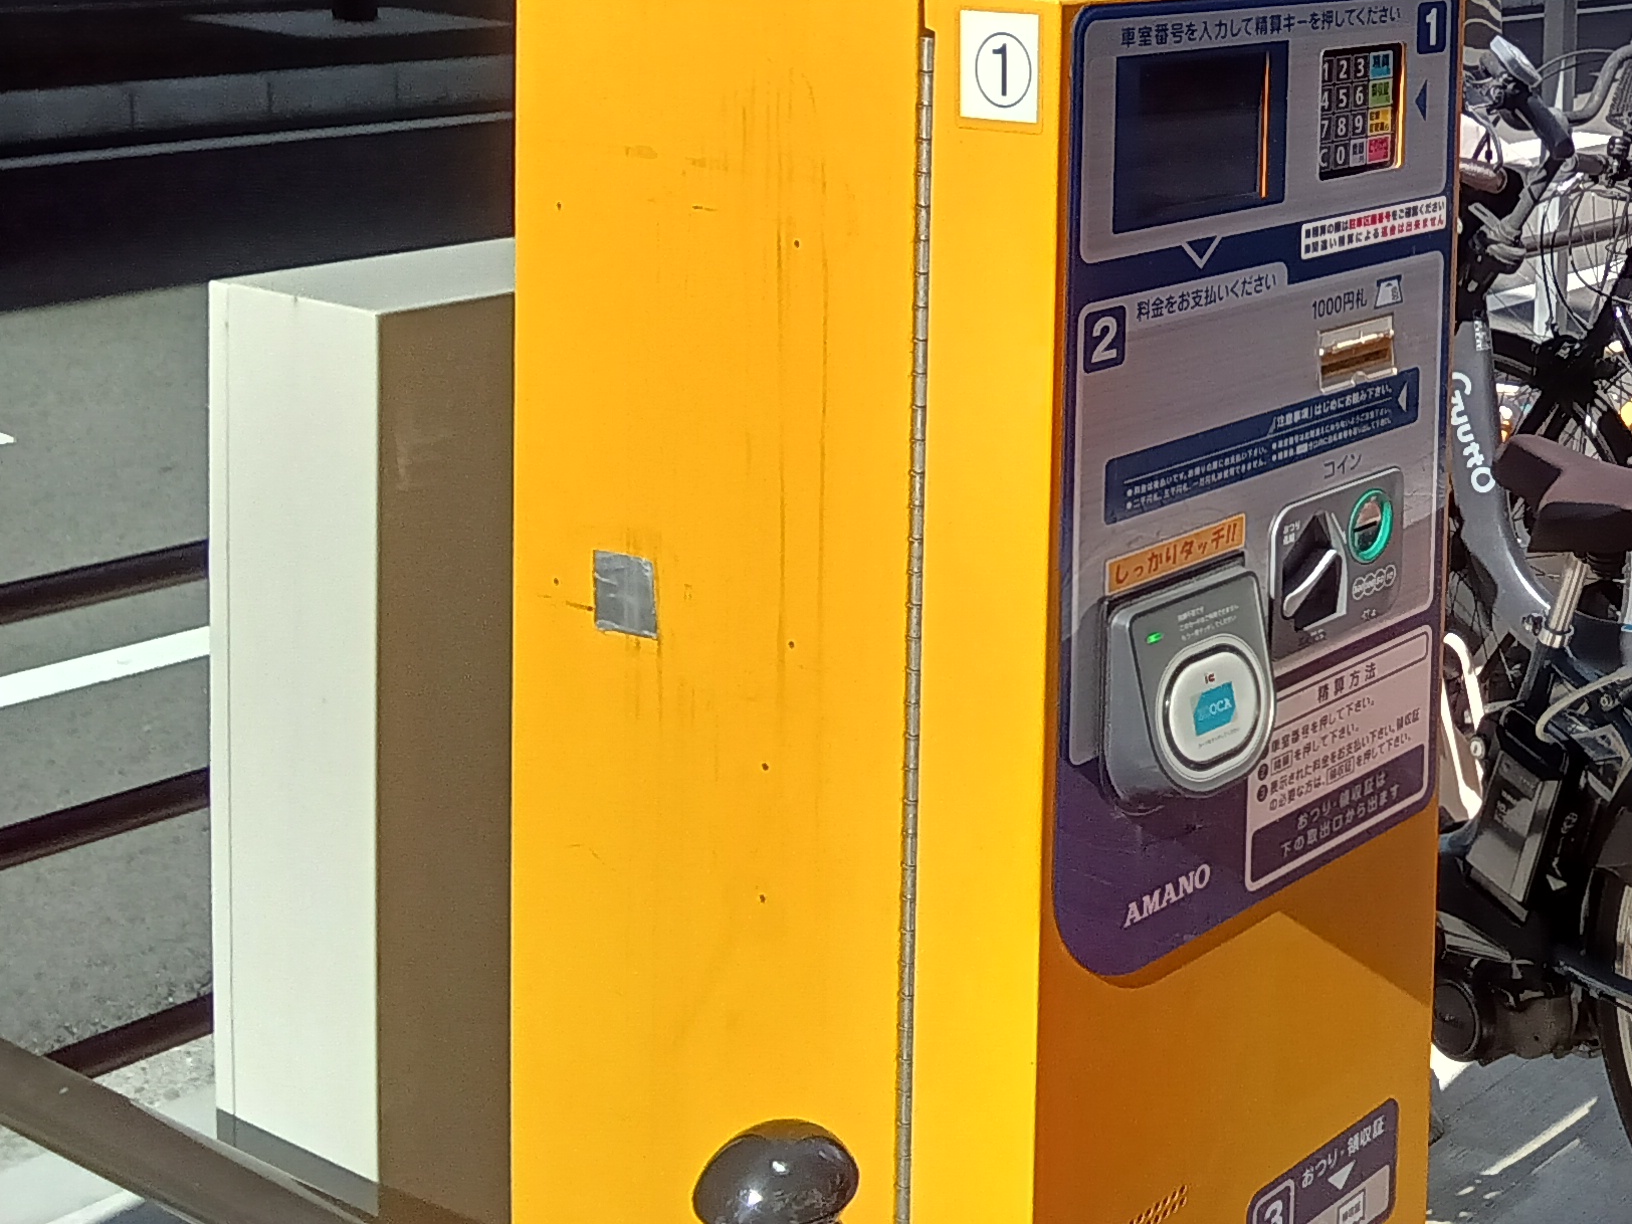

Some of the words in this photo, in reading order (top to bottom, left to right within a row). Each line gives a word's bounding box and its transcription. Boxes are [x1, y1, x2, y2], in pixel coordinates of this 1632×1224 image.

[1120, 6, 1401, 48] 車室番号を入力して精算キーを押してください
[1424, 7, 1438, 46] 1
[1339, 60, 1348, 79] 2
[1356, 58, 1365, 77] 3
[1321, 90, 1329, 109] 4
[1338, 88, 1347, 107] 5
[1355, 86, 1364, 105] 6
[1321, 120, 1329, 138] 7
[1337, 117, 1346, 136] 8
[1354, 115, 1363, 133] 9
[1336, 146, 1345, 165] 0
[1136, 274, 1276, 322] 料金をお支払いください
[1312, 288, 1368, 319] 1000円札
[1091, 317, 1118, 364] 2
[1323, 454, 1362, 479] コイン
[1115, 526, 1238, 584] しっかりタッチ!!
[1317, 662, 1376, 703] 精算方法
[1294, 724, 1359, 761] を押して下さい。
[1356, 733, 1412, 767] を押して下さい。
[1281, 784, 1400, 857] 下の取出口から出ます
[1297, 771, 1386, 830] おつり・領収証は
[1122, 863, 1211, 929] AMANO
[1302, 1114, 1386, 1189] おつり・領収証
